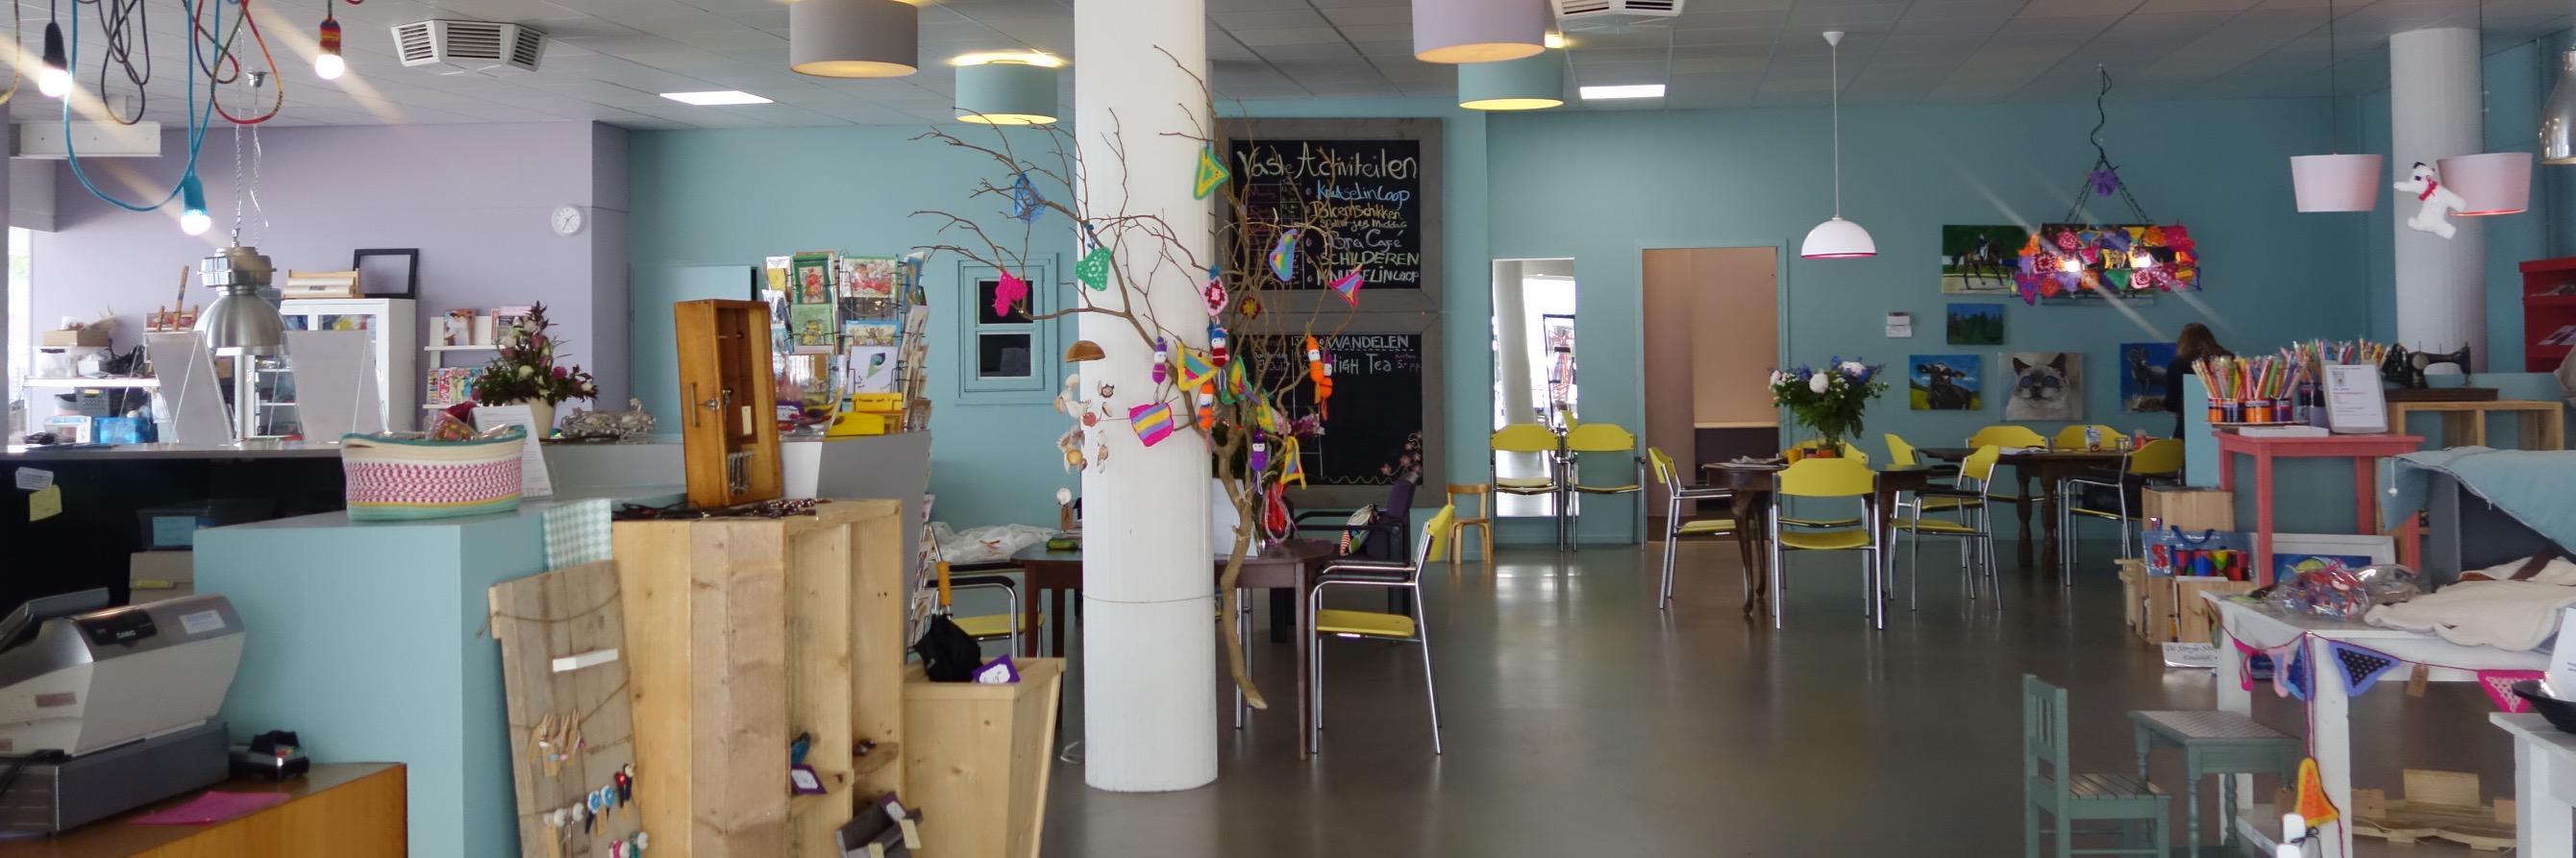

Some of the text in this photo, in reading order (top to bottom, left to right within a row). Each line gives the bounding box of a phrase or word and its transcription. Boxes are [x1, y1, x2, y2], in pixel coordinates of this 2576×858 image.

[1365, 229, 1404, 253] Café
[1321, 251, 1420, 266] SCHILDEREN
[1328, 335, 1410, 349] WANDELEN
[1366, 353, 1392, 375] Tea
